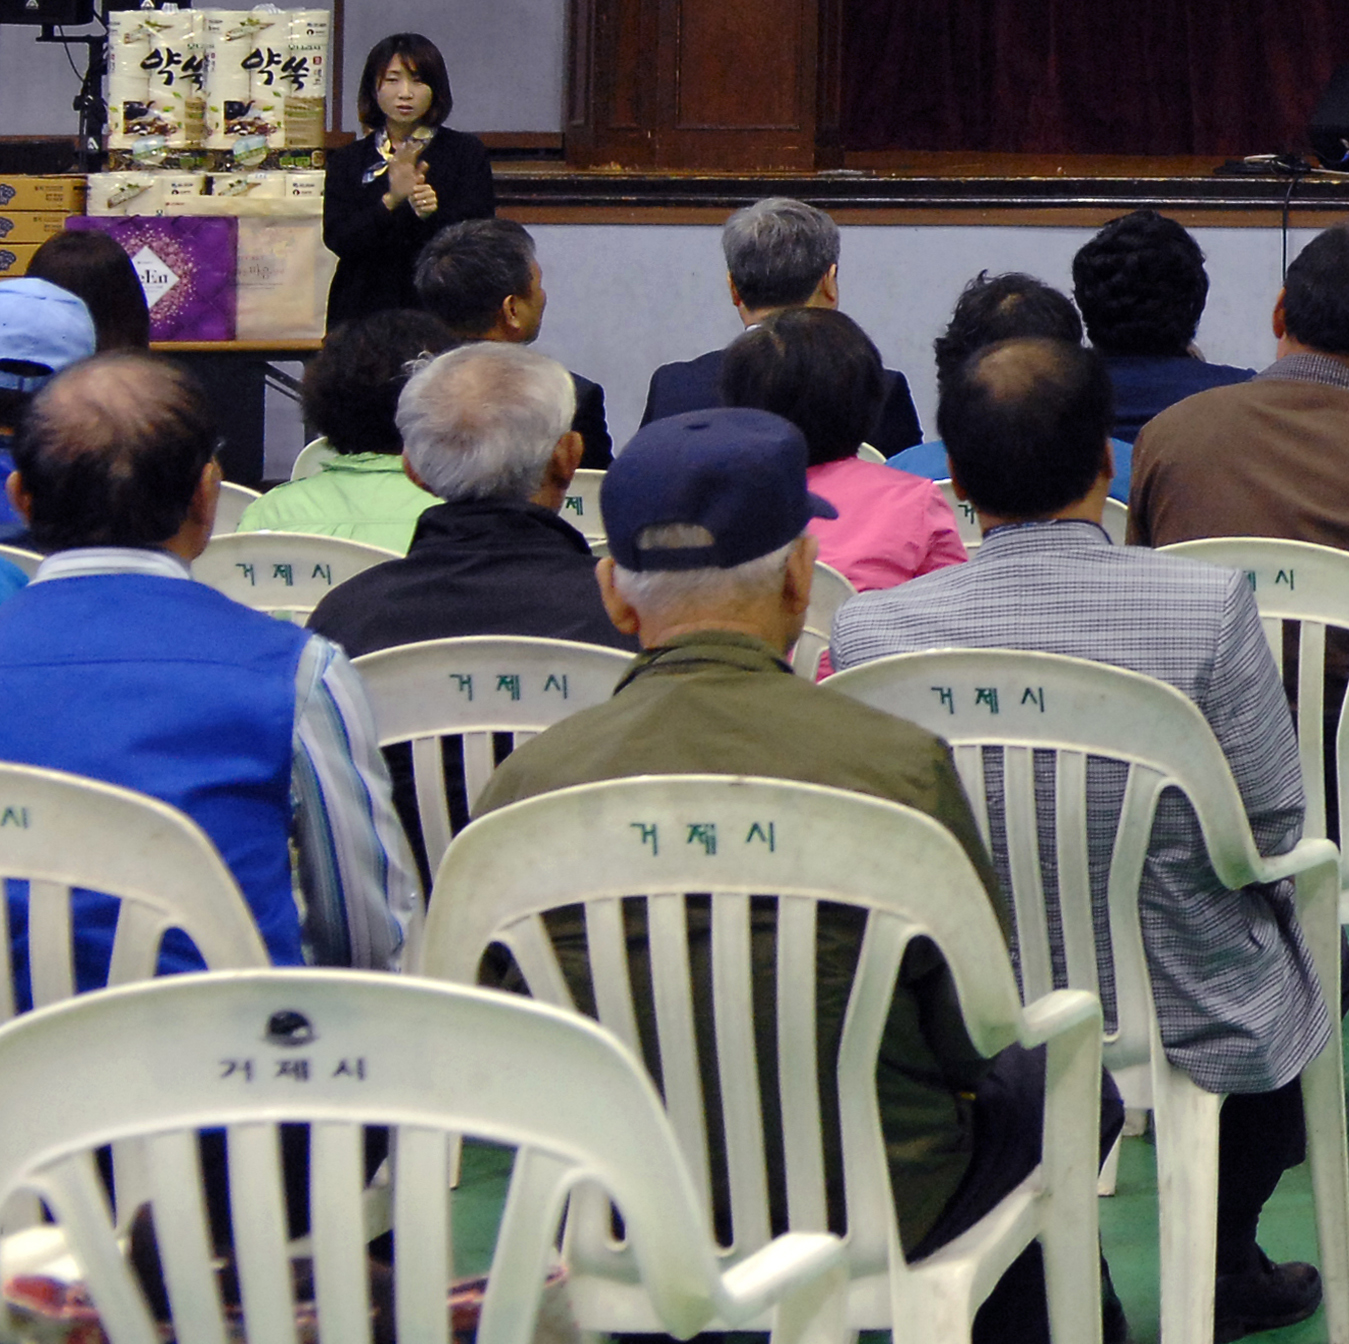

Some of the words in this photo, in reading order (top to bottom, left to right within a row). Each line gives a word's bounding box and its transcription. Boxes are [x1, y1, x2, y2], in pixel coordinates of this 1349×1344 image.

[234, 563, 332, 587] 거제시
[448, 673, 569, 703] 거제시
[930, 685, 1046, 716] 거제시
[628, 820, 776, 857] 거제시
[218, 1056, 368, 1084] 거제시
